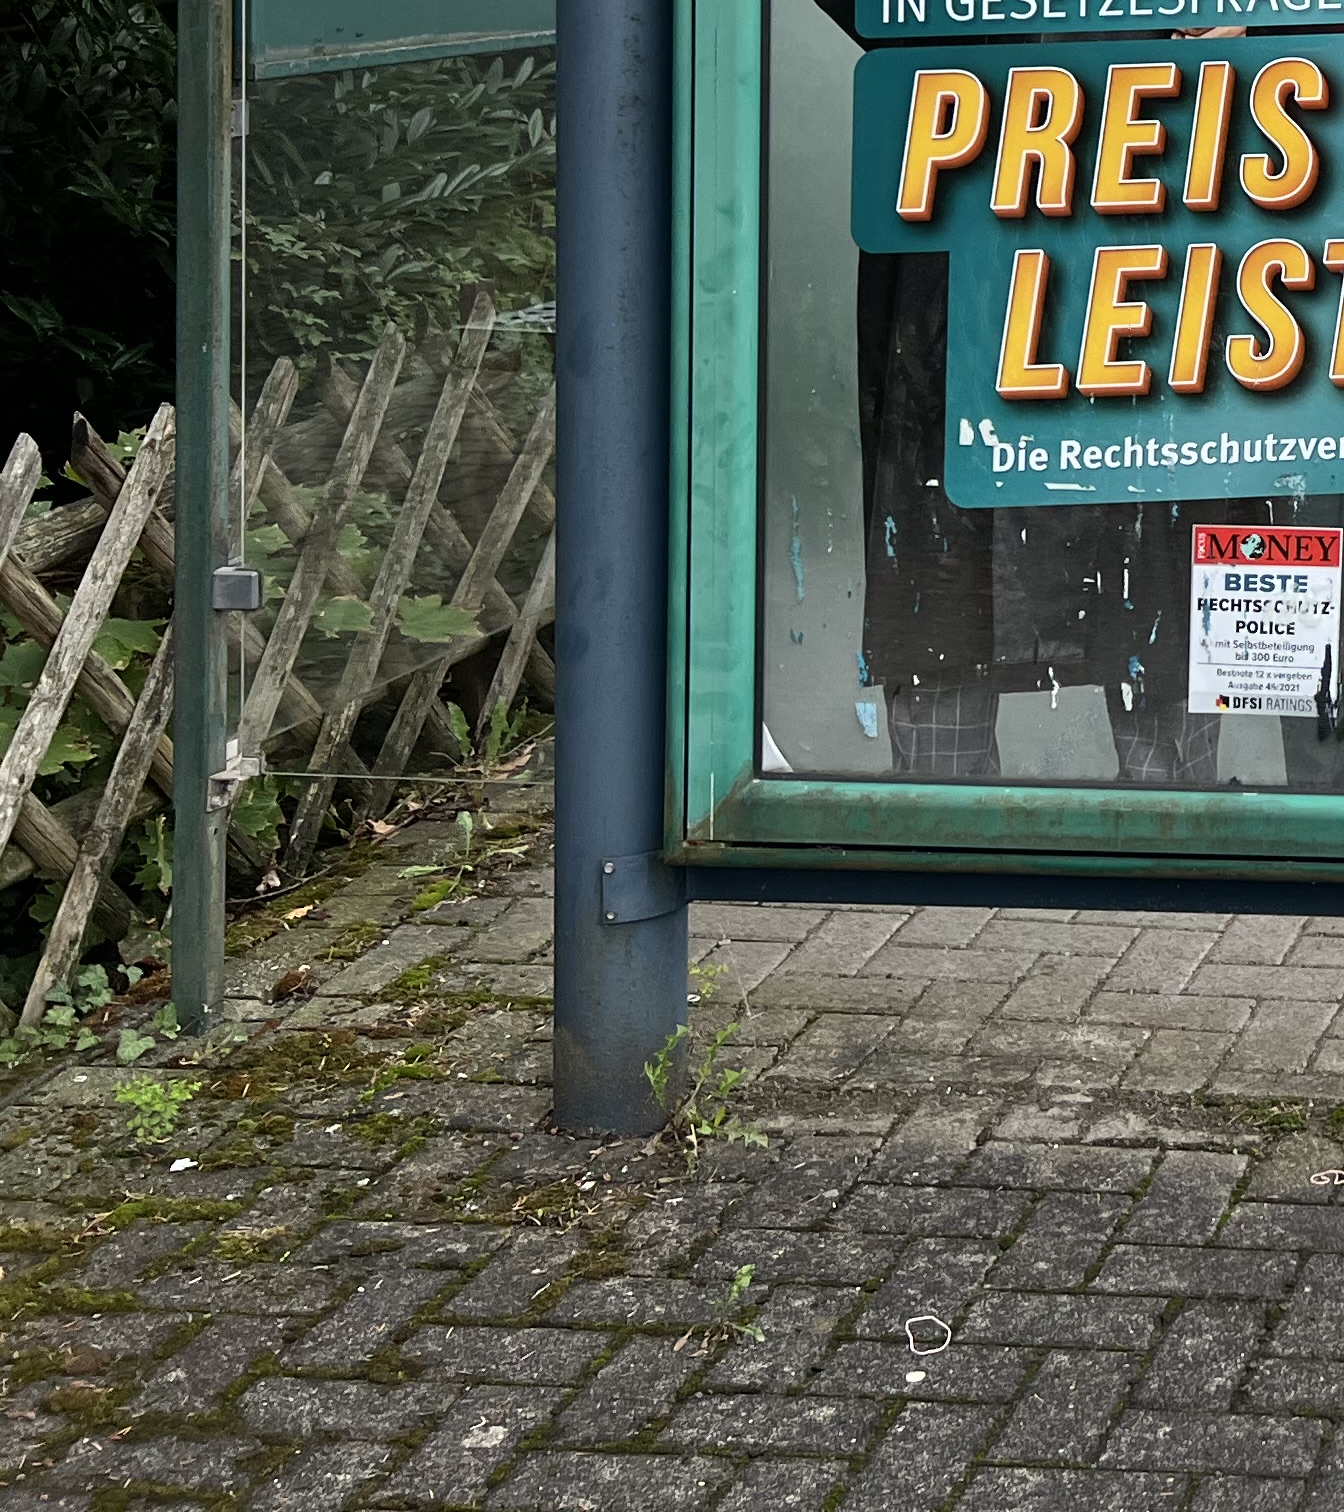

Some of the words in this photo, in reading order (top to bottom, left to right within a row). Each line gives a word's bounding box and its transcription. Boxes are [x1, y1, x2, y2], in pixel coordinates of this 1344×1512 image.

[896, 57, 1329, 221] PREIS
[991, 439, 1049, 473] Die
[1224, 573, 1309, 593] BESTE
[1235, 620, 1296, 636] POLICE
[1215, 640, 1231, 649] mit
[1252, 653, 1270, 662] 300
[1273, 653, 1294, 663] Euro
[1217, 669, 1253, 678] Bestnote
[1256, 671, 1265, 679] 12
[1233, 697, 1262, 711] DFSI
[1266, 698, 1313, 713] RATINGS
